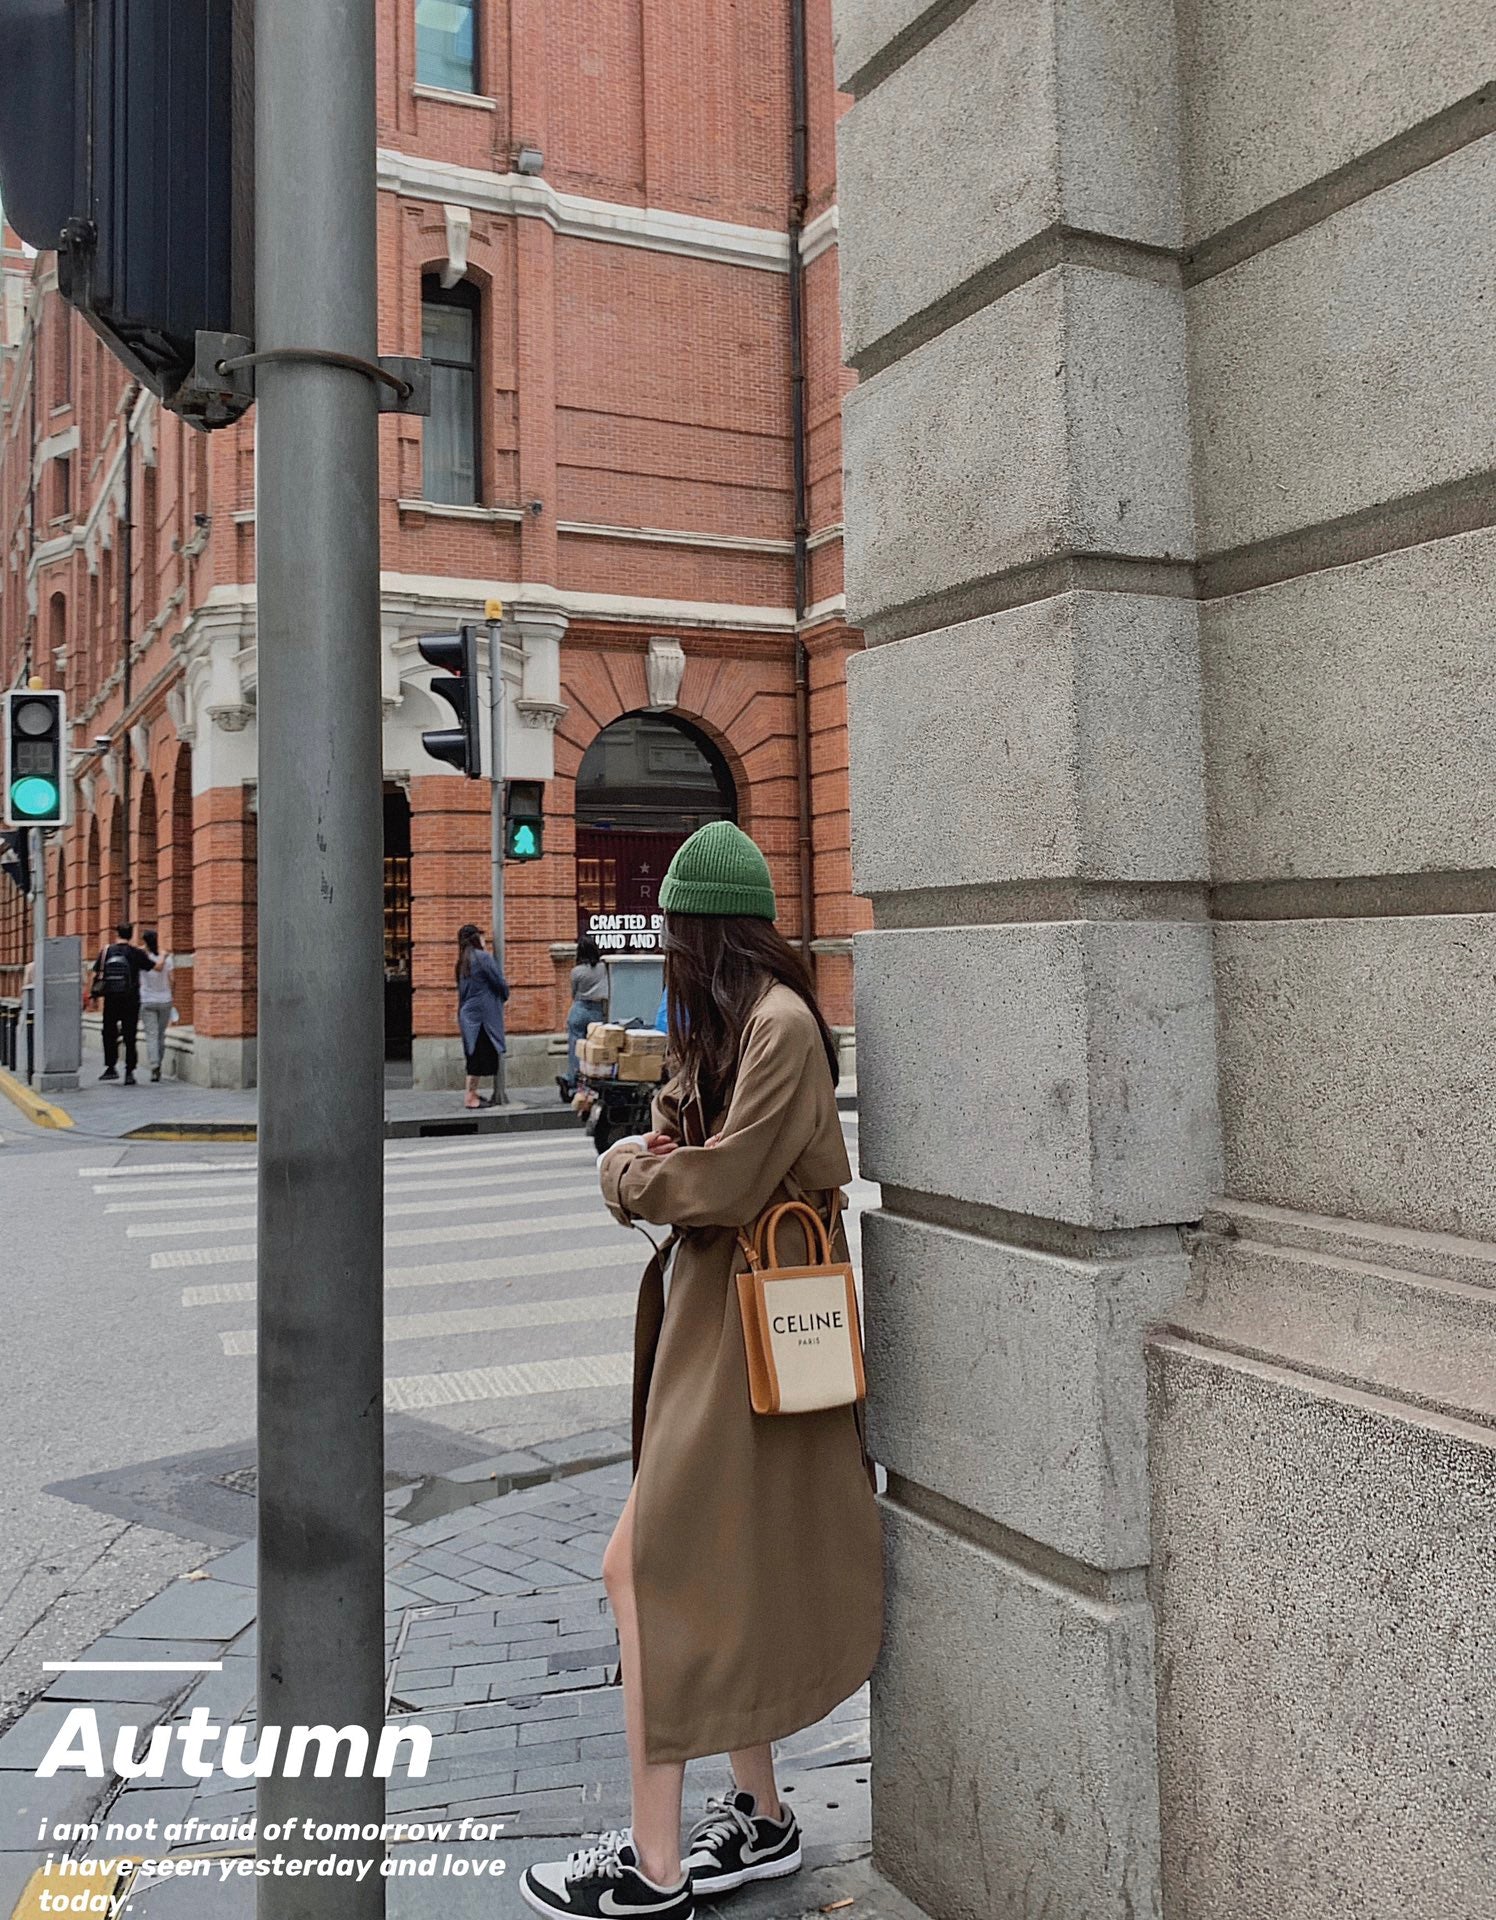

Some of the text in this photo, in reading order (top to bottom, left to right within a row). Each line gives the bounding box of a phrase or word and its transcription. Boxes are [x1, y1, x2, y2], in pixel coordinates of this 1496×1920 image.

[640, 885, 650, 898] R
[590, 914, 646, 930] CRAFTED
[629, 934, 656, 949] AND
[773, 1311, 843, 1334] CELINE
[798, 1337, 820, 1346] PARIS
